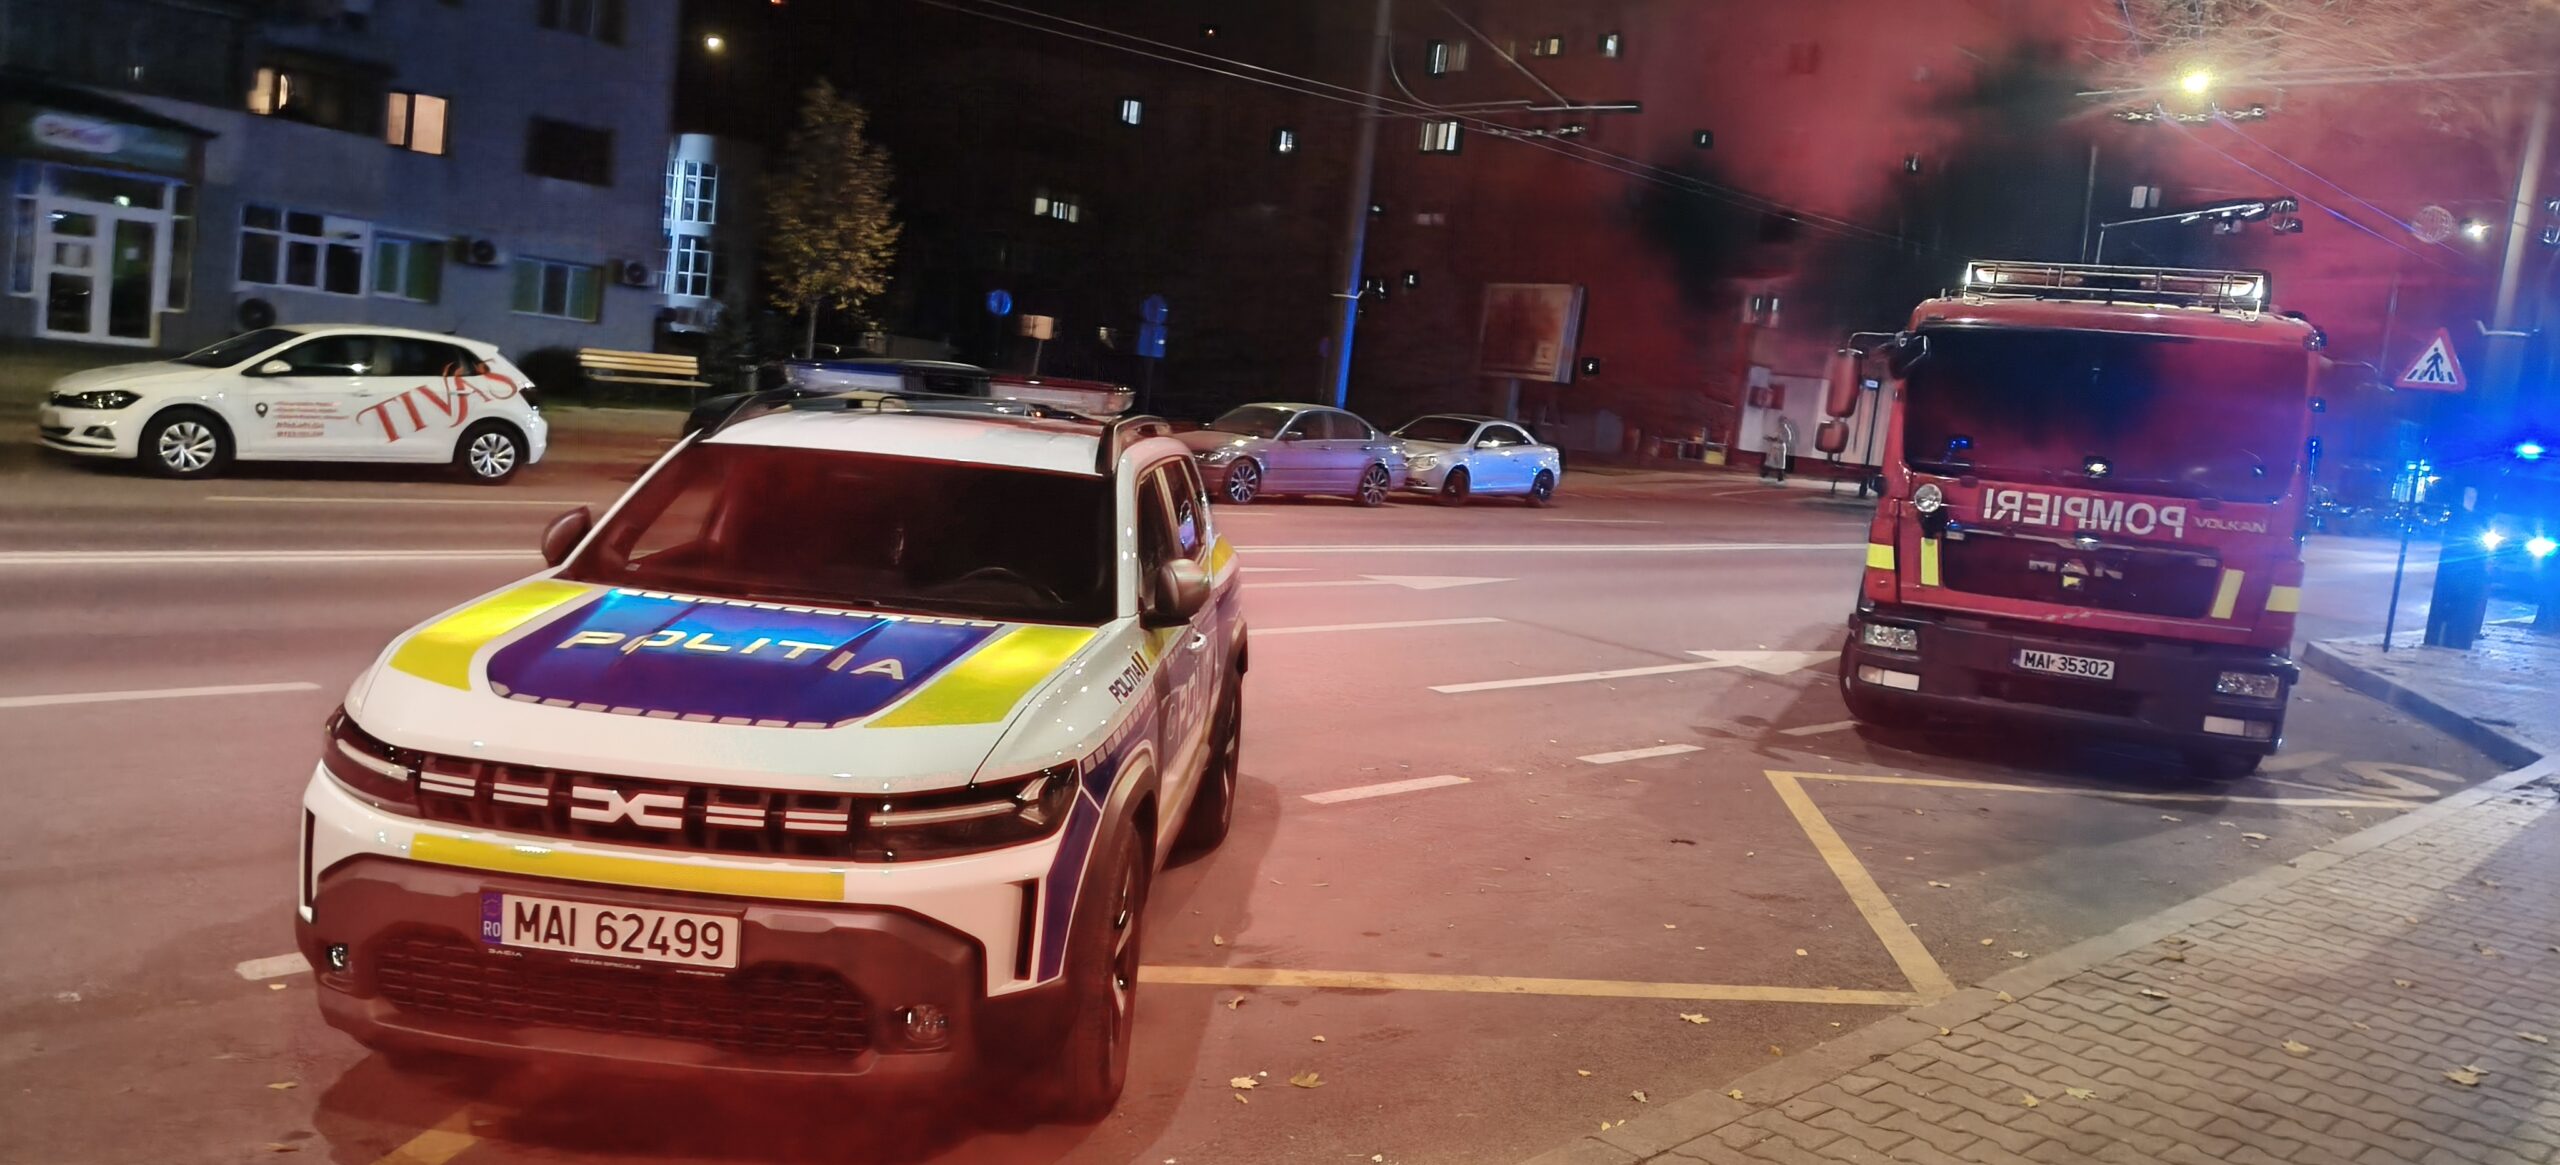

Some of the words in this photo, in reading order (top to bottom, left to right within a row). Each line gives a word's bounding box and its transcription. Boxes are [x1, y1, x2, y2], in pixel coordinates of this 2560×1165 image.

[356, 358, 519, 443] TIVAS
[2192, 515, 2267, 534] VOLKAN
[556, 630, 904, 680] POLITIA
[2024, 652, 2051, 669] MAI
[2057, 656, 2110, 677] 35302
[483, 920, 501, 937] RO
[514, 901, 576, 946] MAI
[595, 911, 724, 960] 62499
[488, 948, 522, 957] DACIA
